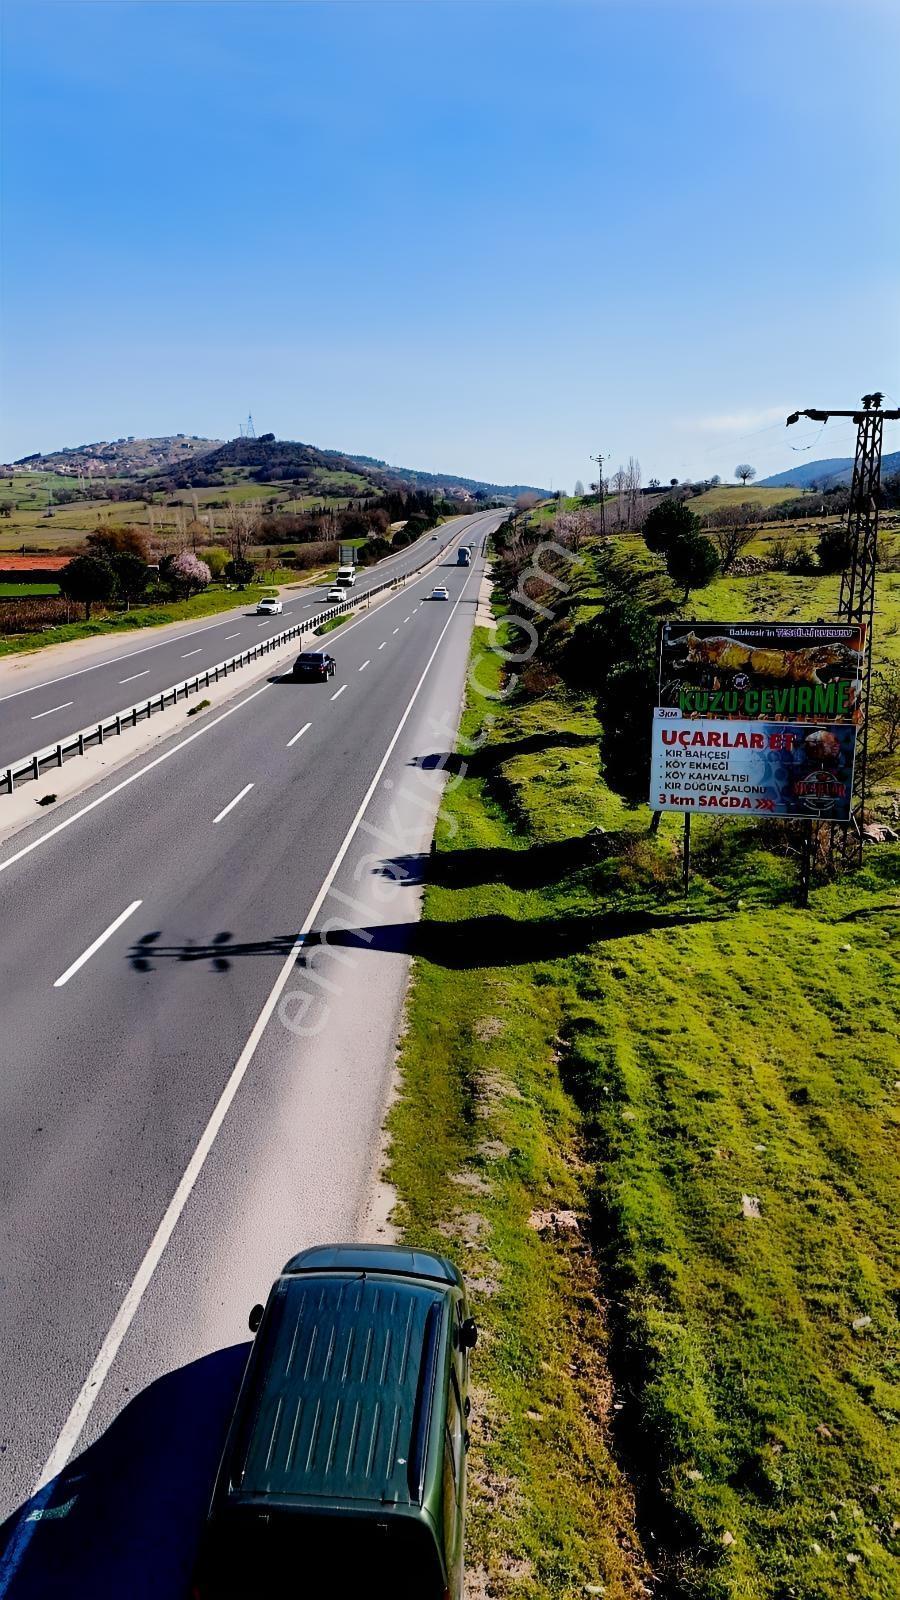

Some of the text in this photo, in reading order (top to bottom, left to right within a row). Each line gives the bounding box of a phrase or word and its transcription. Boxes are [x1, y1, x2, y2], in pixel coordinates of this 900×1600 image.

[679, 690, 738, 713] KUZU
[661, 730, 796, 751] UÇARLAR ET
[665, 749, 730, 760] KIR BAHÇESİ
[665, 760, 729, 771] KÖY EKMEĞİ
[665, 771, 749, 782] KÖY KAHVALTISI
[664, 782, 767, 794] KIR DÜĞÜN SALONU
[658, 792, 752, 808] 3 km SAĞDA
